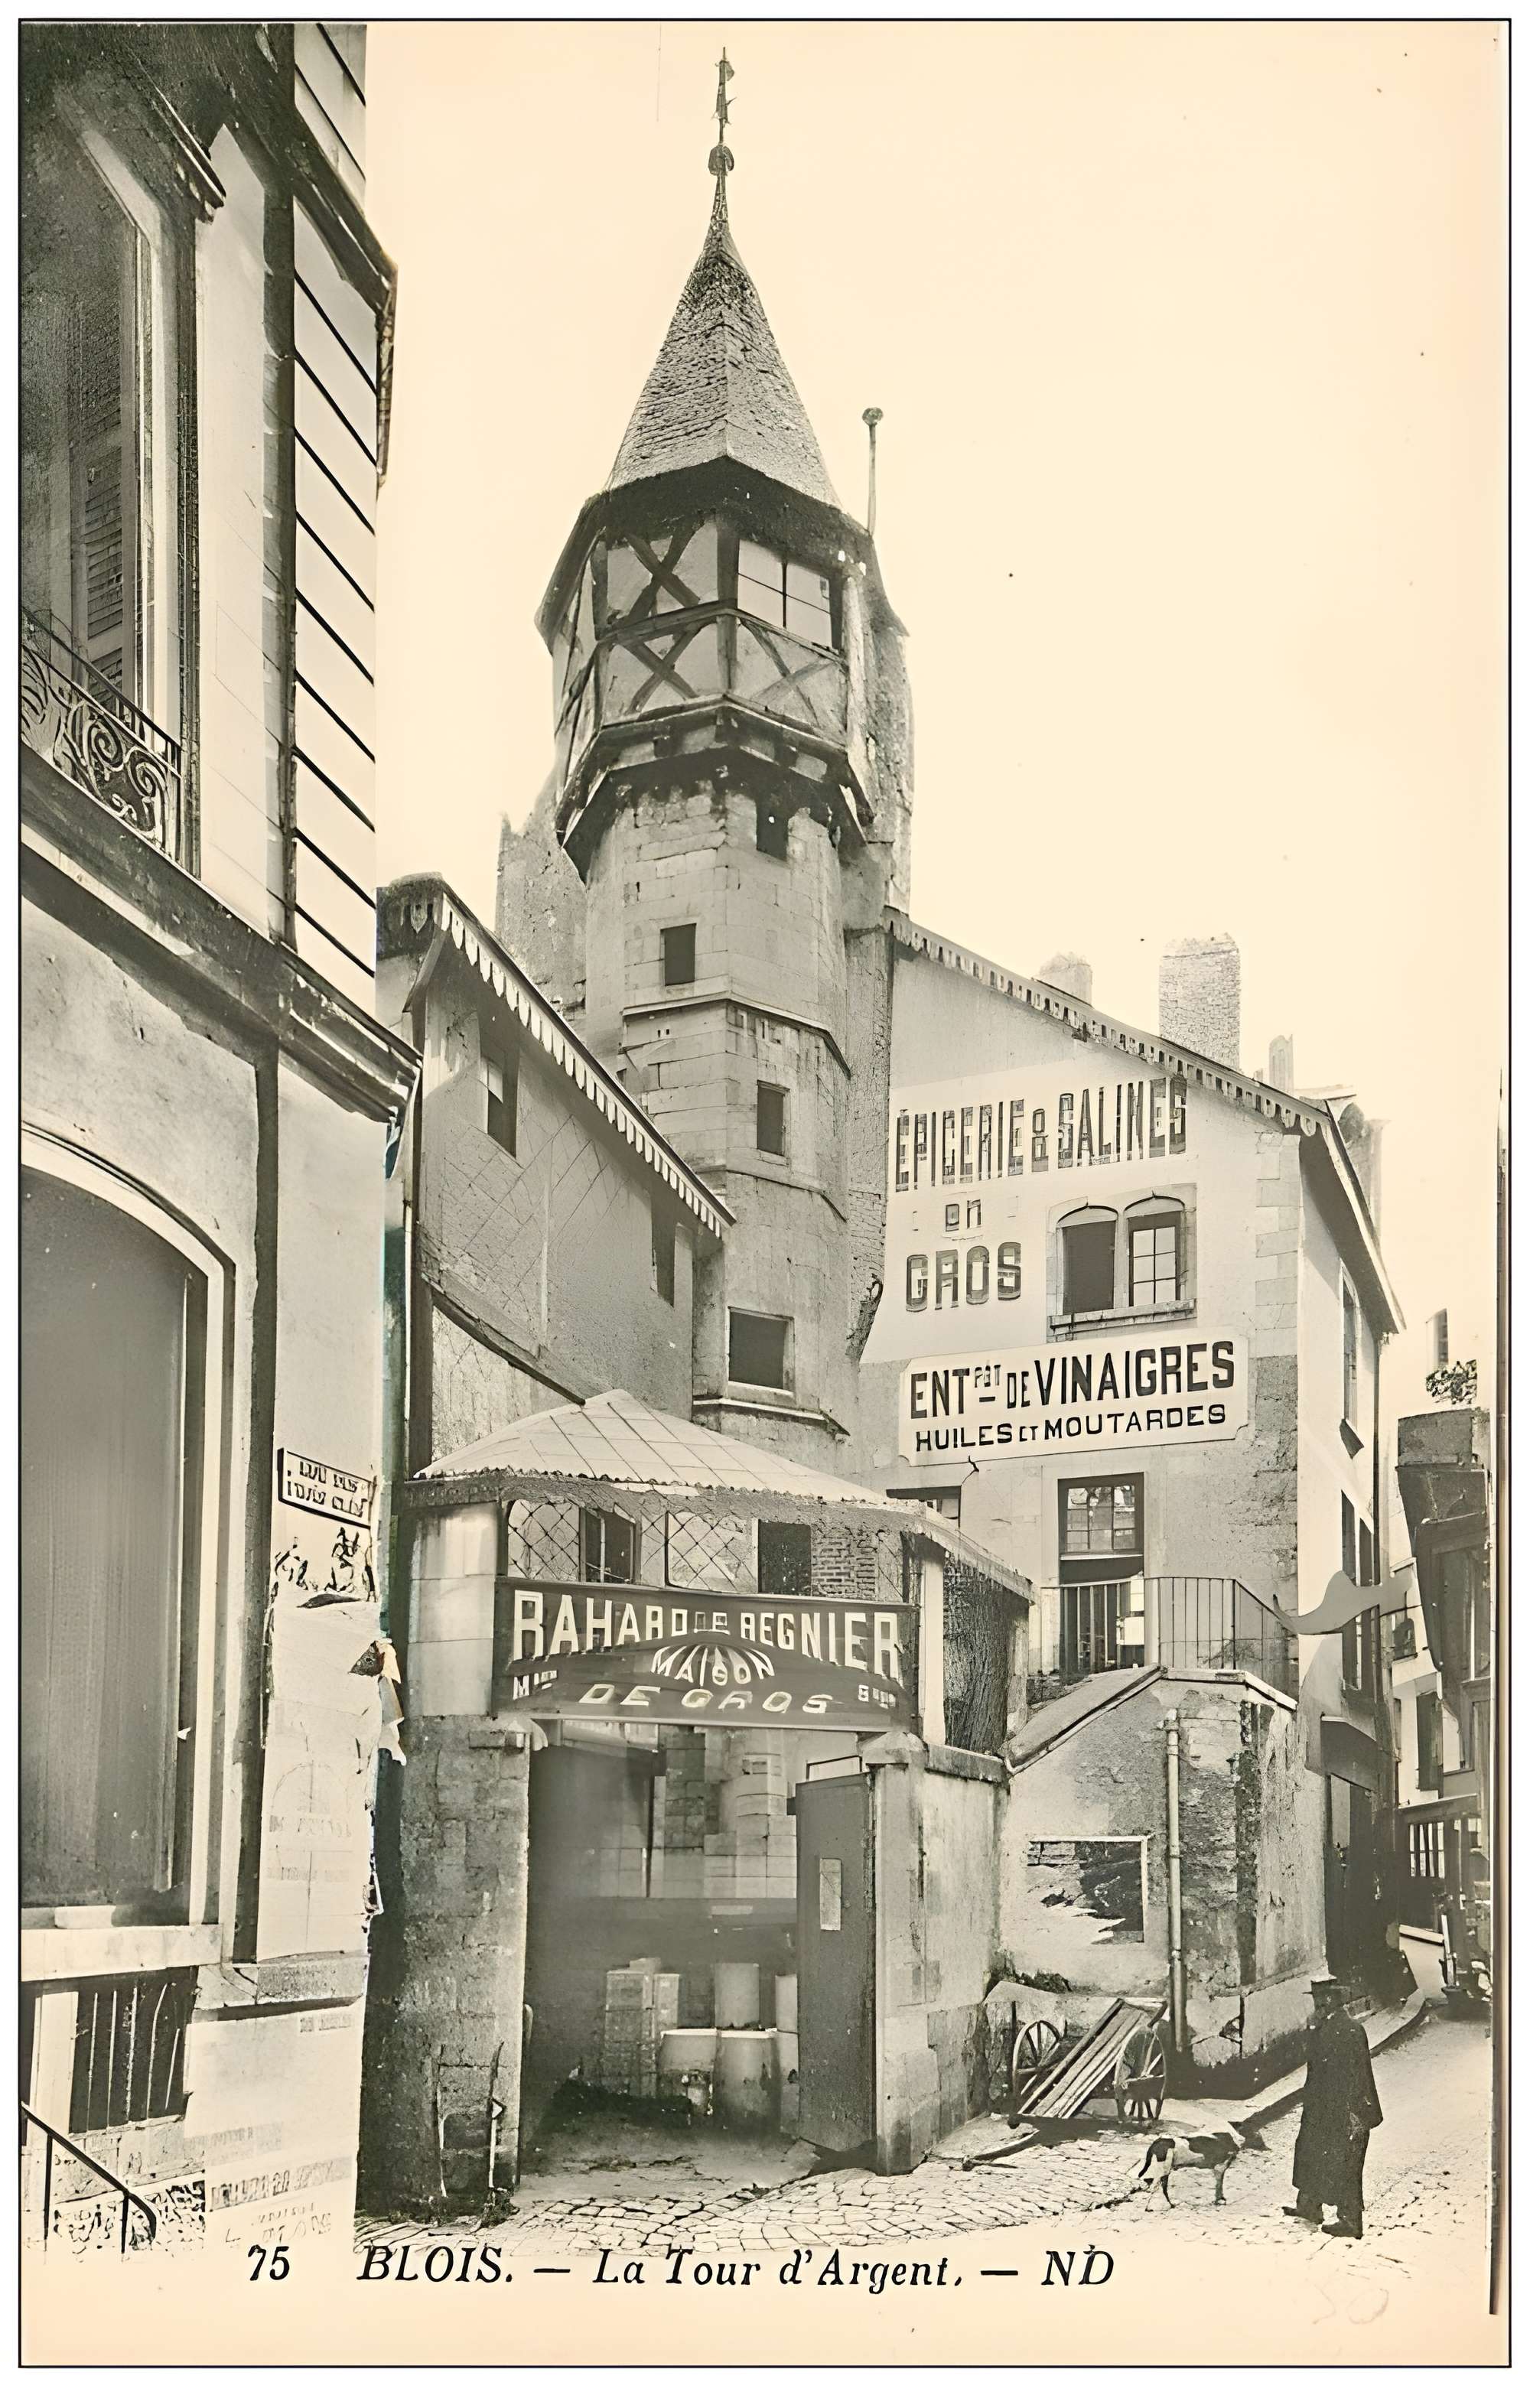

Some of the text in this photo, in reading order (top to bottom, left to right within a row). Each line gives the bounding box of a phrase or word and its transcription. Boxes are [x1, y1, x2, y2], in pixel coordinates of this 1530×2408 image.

[906, 1241, 1021, 1313] GROS
[1007, 1371, 1030, 1409] DE
[1034, 1341, 1235, 1406] VINAIGRES
[916, 1423, 1013, 1453] HUILES
[1044, 1404, 1226, 1441] MOUTARDES
[650, 1645, 775, 1687] MAISON
[578, 1684, 661, 1707] DE
